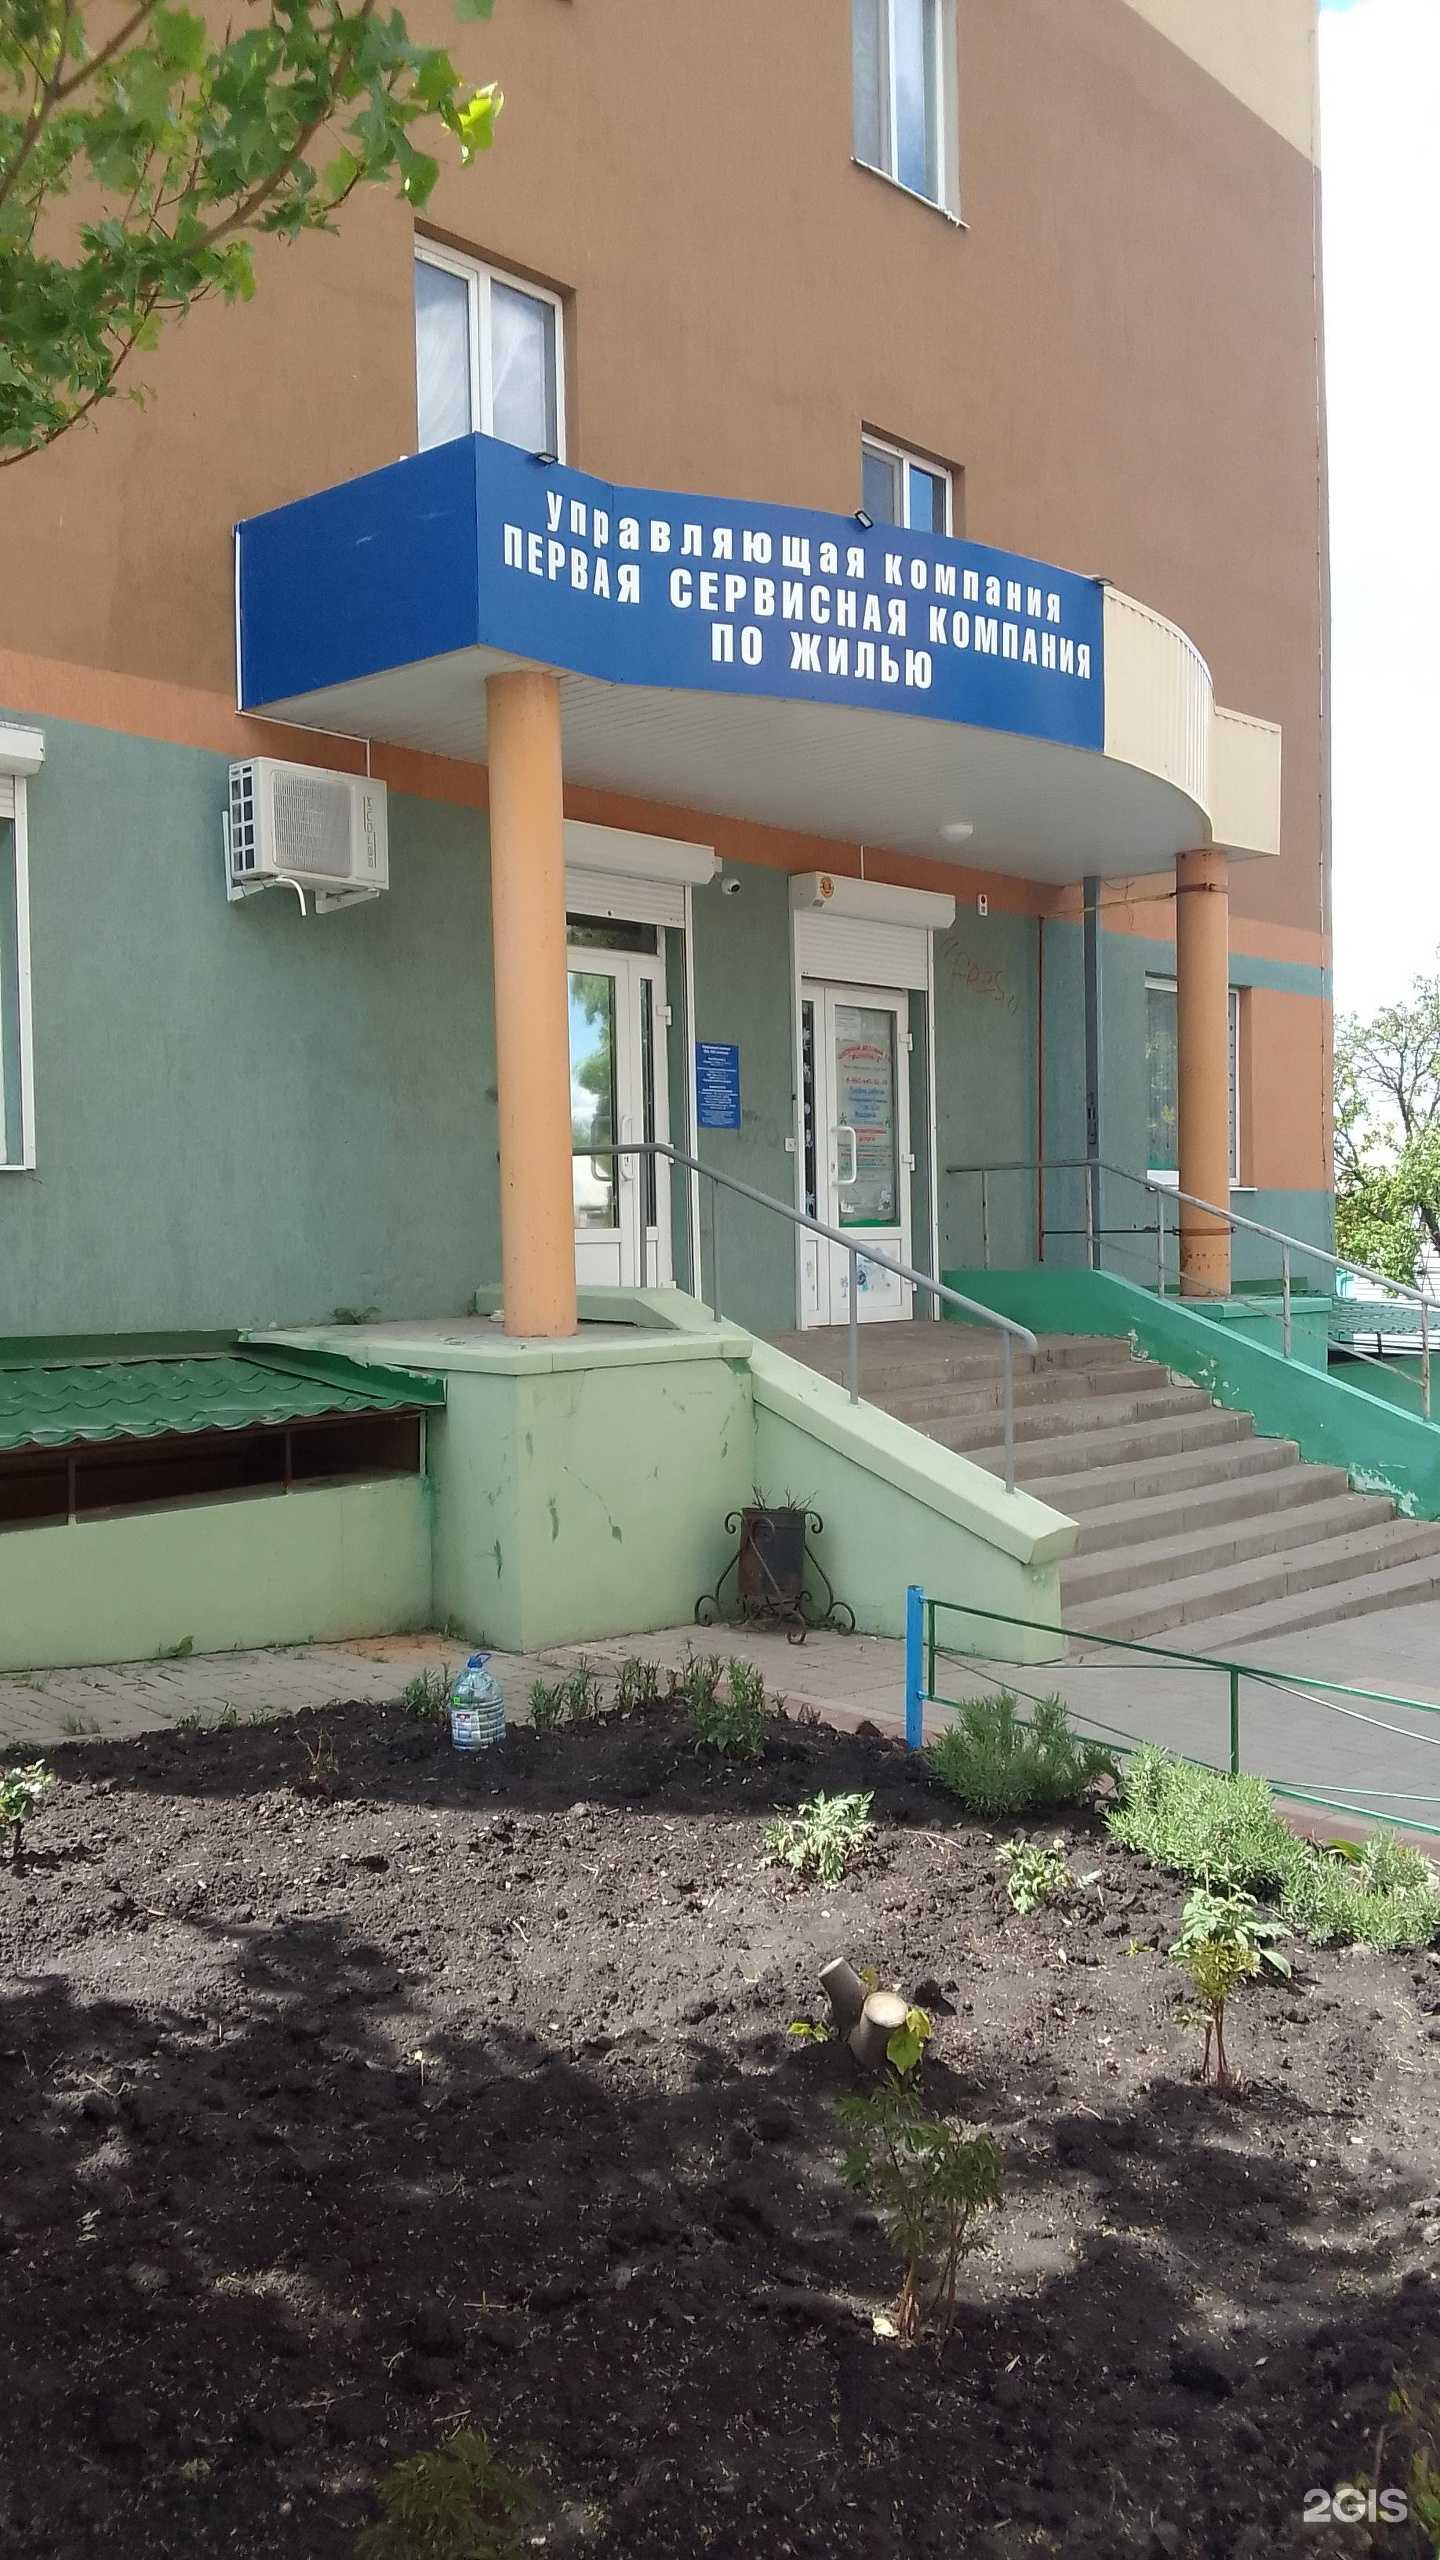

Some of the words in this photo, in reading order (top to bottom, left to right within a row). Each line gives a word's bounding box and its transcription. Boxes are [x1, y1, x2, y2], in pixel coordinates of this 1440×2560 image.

[502, 523, 641, 605] ПЕРВАЯ
[669, 567, 908, 638] СЕРВИСНАЯ
[928, 604, 1092, 681] КОМПАНИЯ
[884, 553, 1062, 624] компания
[710, 621, 764, 667] ПО
[788, 630, 934, 690] ЖИЛЬЮ
